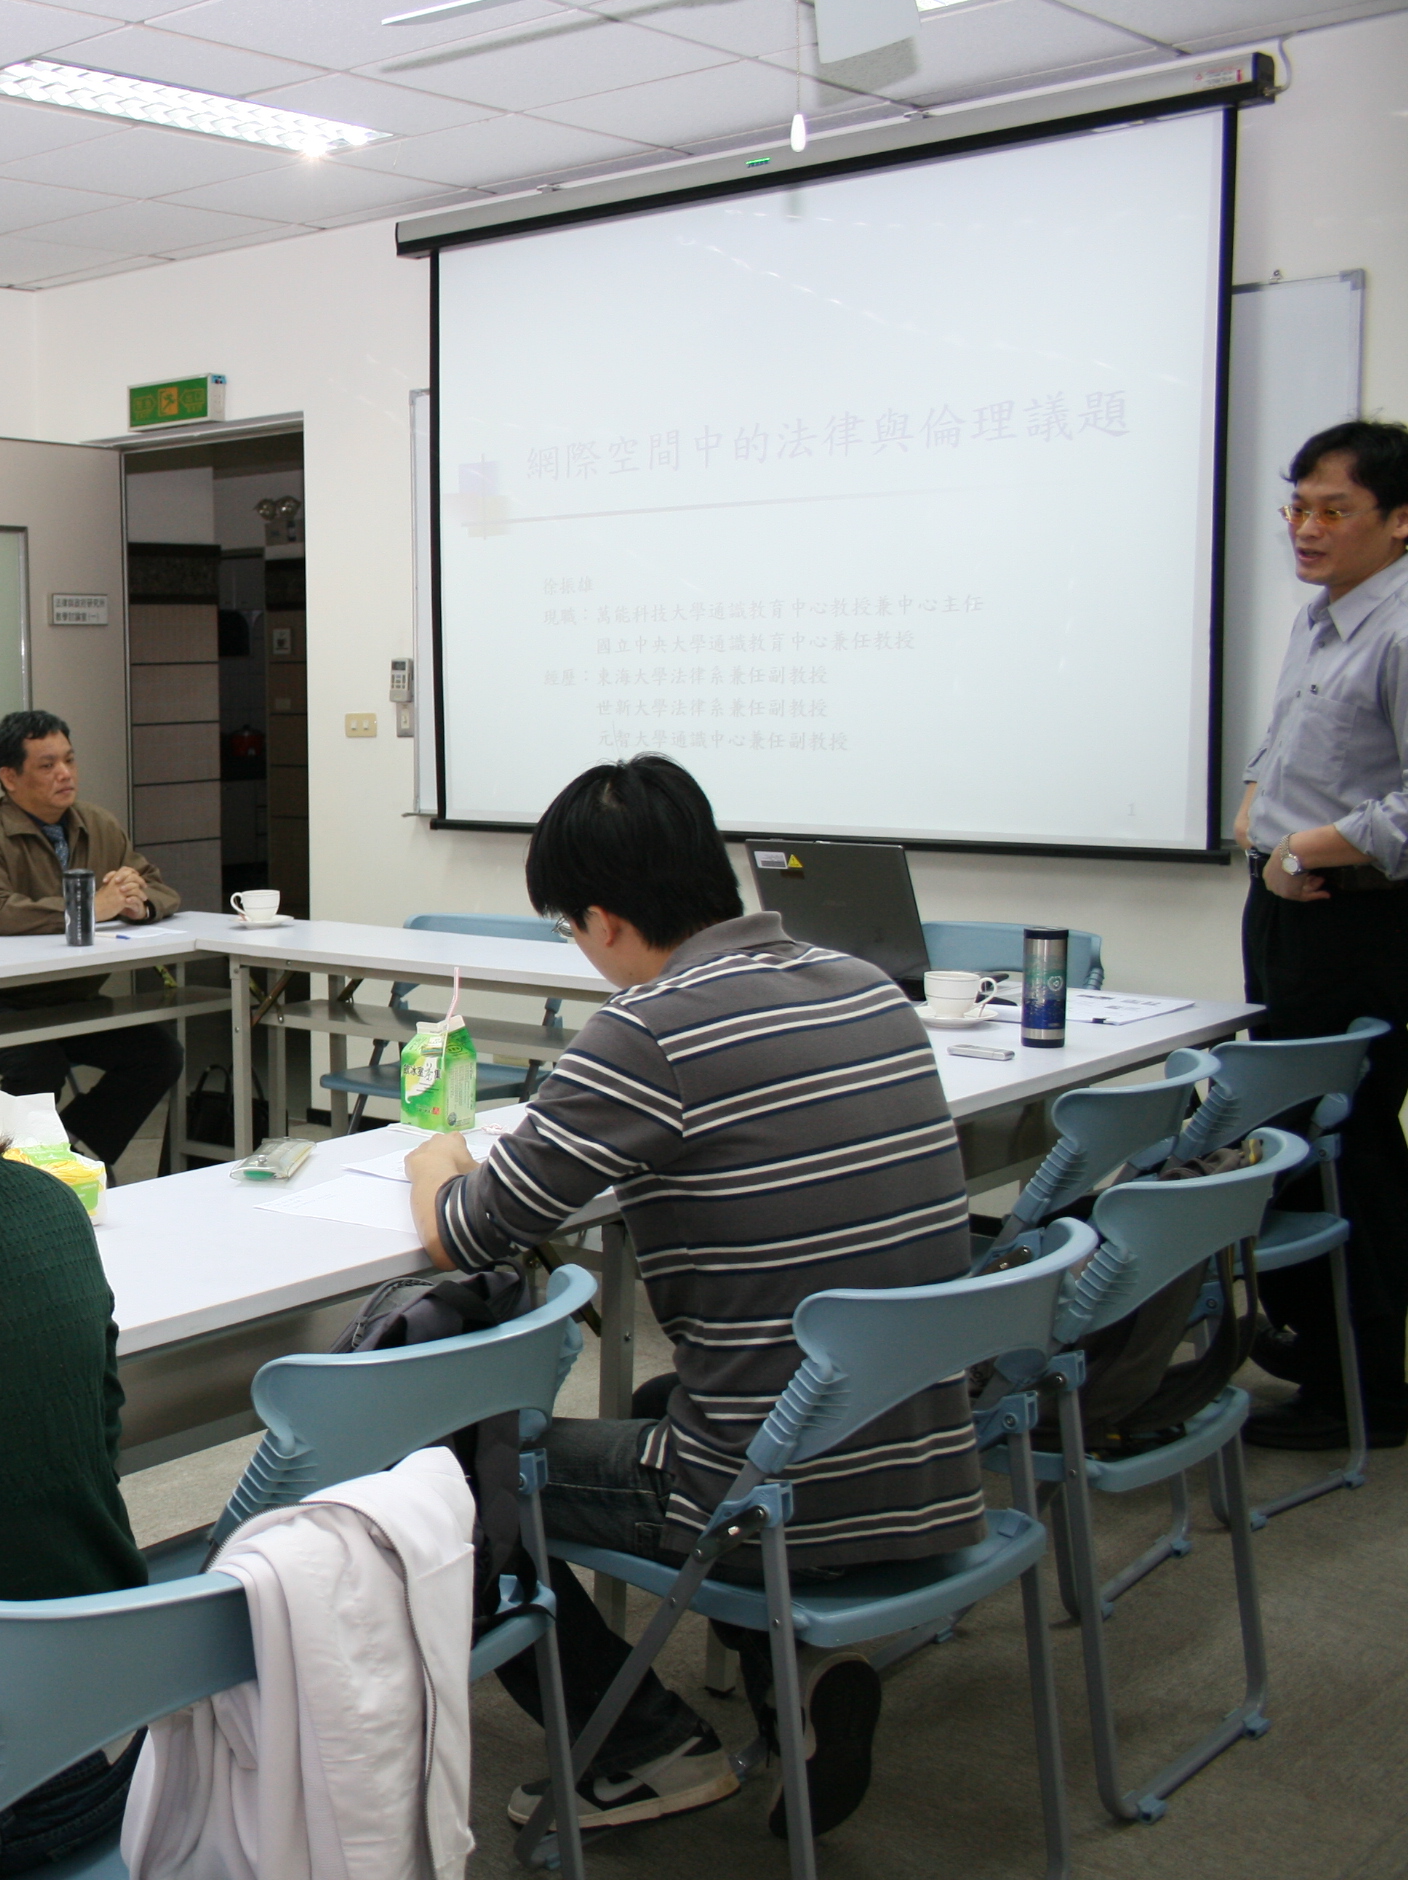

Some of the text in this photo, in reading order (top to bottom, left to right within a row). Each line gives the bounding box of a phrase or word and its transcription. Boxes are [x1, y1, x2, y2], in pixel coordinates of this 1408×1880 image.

[524, 389, 1132, 481] 網際空間中的法律與倫理議題
[542, 575, 595, 596] 徐振雄
[595, 630, 916, 656] 國立中央大學通識教育中心兼任教授
[595, 697, 829, 720] 世新大學法律系兼任副教授
[597, 728, 849, 752] 元智大學通識中心兼任副教授
[1126, 802, 1137, 817] 1
